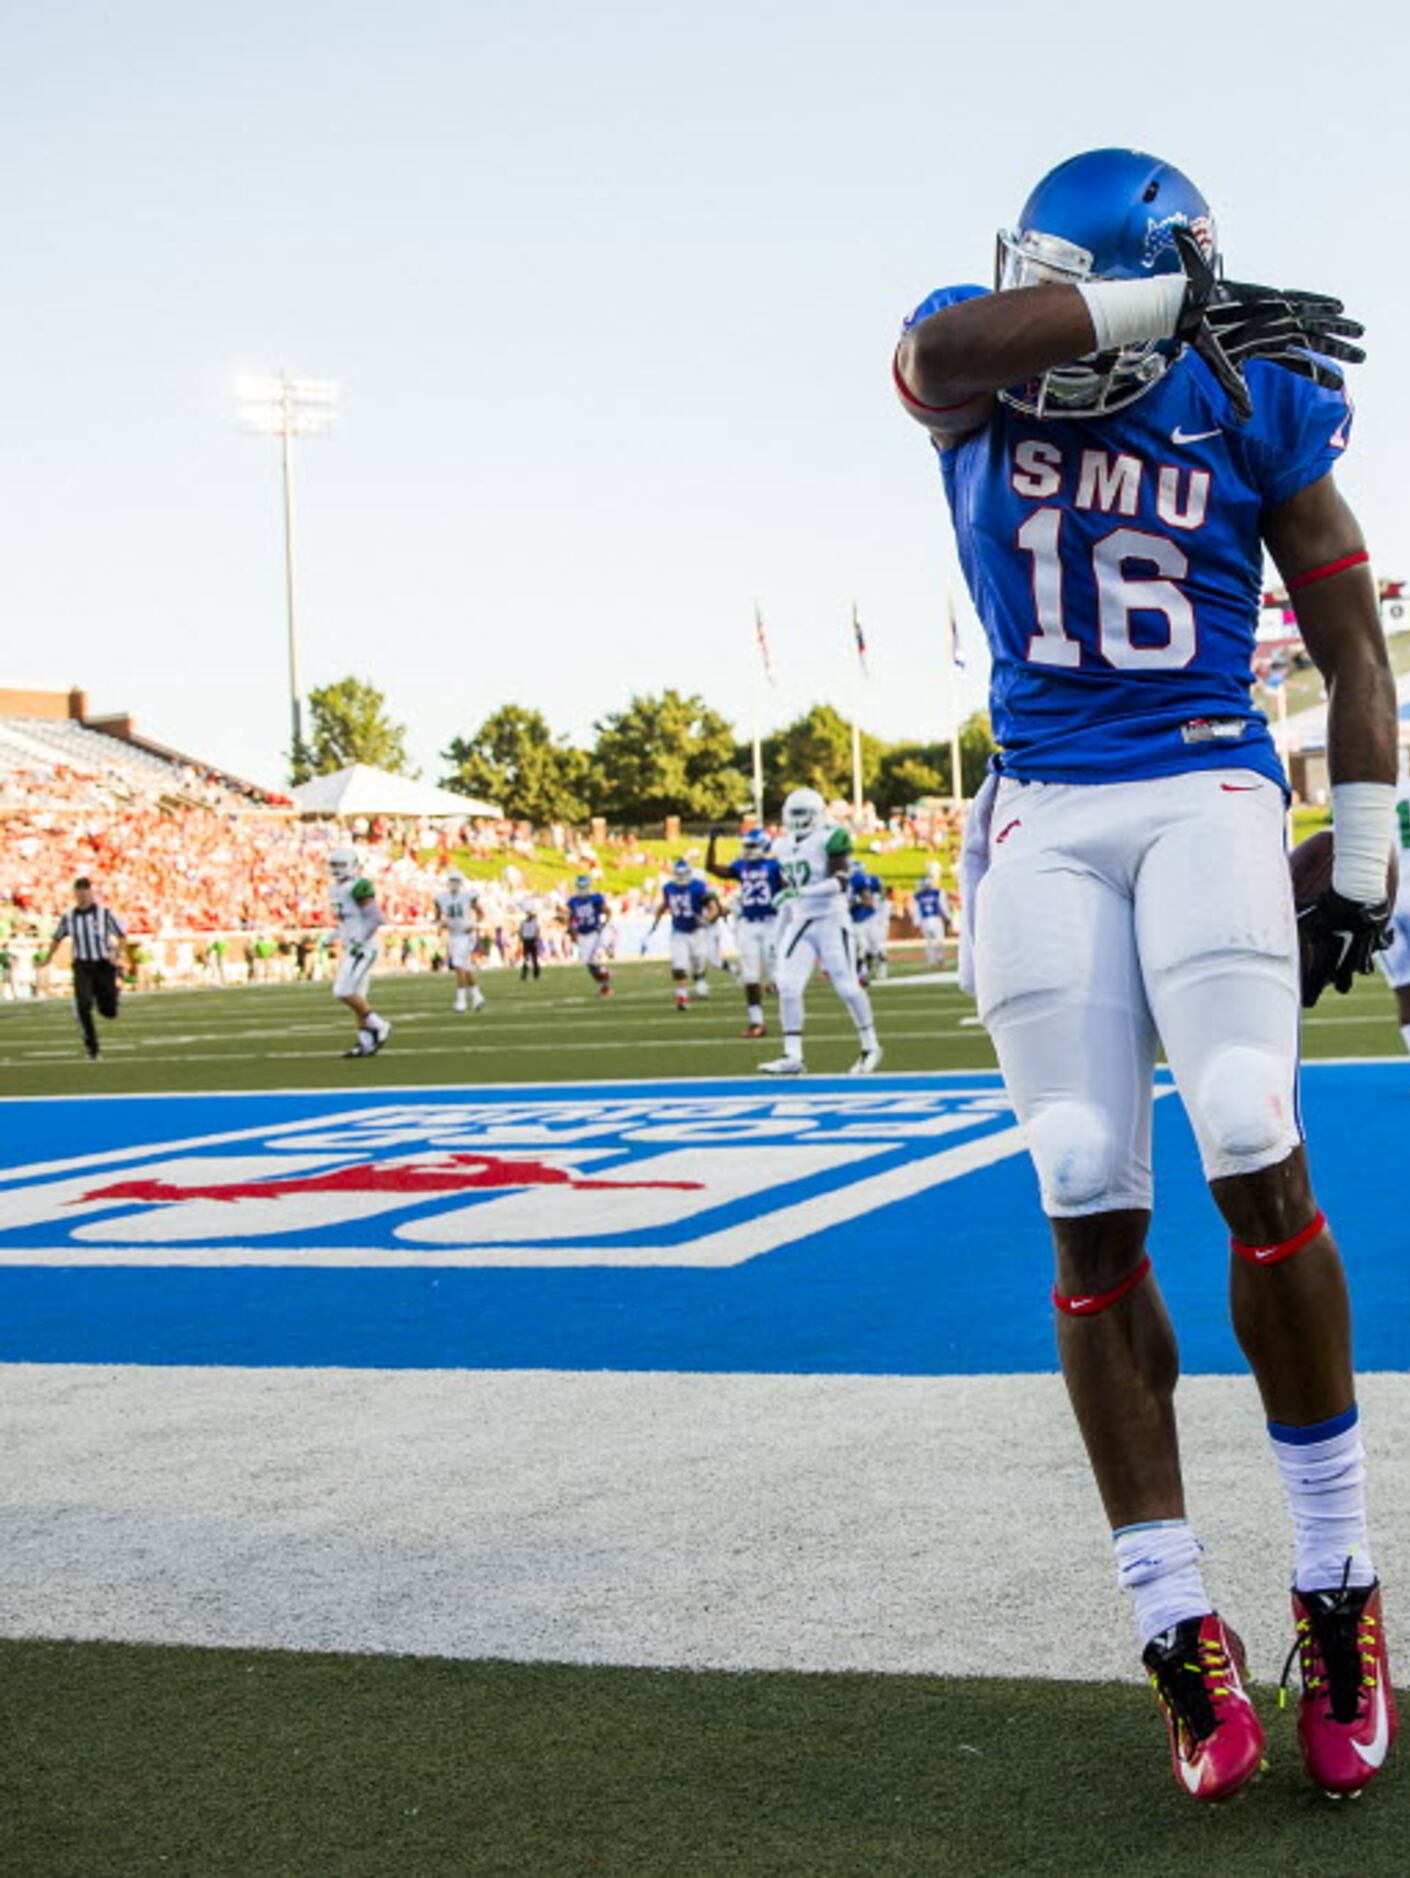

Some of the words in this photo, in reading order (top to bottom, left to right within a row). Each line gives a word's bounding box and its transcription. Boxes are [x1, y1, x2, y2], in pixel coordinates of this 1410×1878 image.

[1011, 438, 1211, 531] SMU
[1016, 504, 1198, 671] 16
[263, 1112, 999, 1150] FORD
